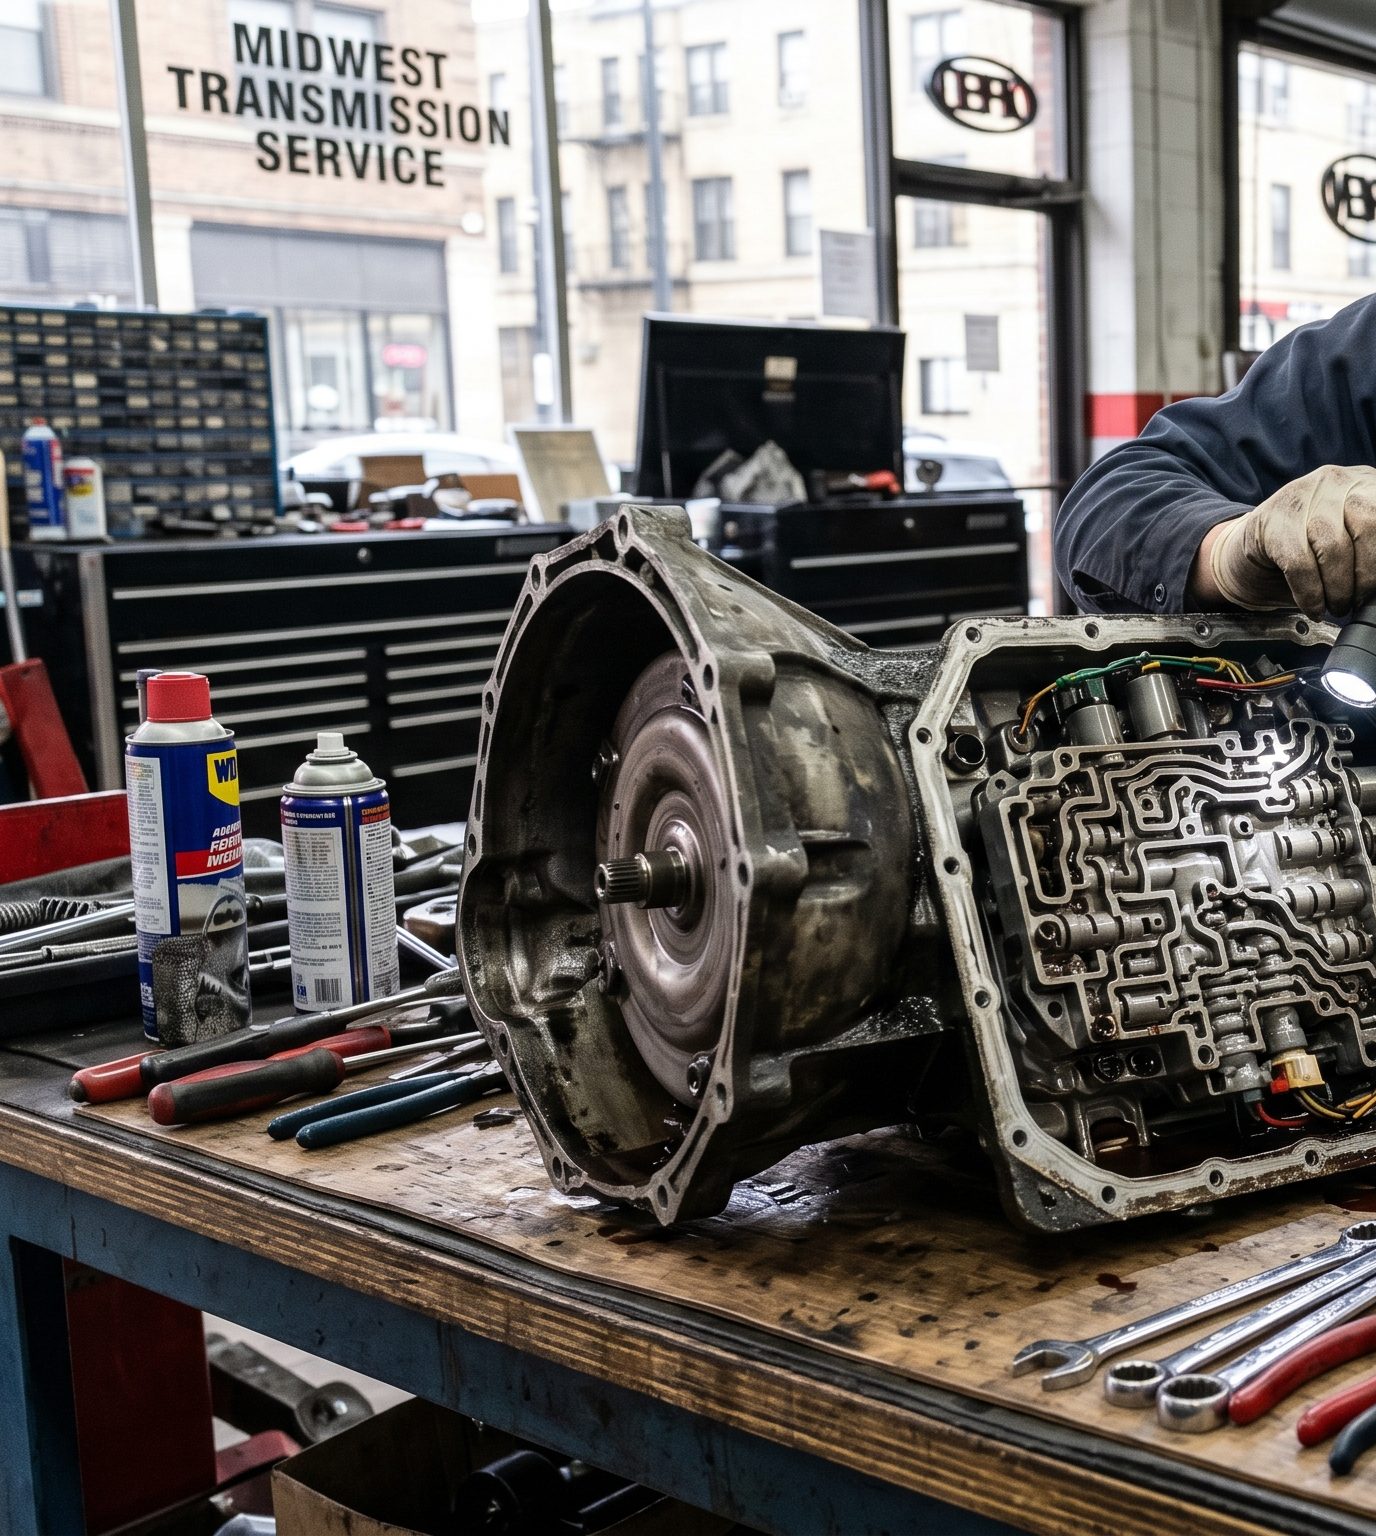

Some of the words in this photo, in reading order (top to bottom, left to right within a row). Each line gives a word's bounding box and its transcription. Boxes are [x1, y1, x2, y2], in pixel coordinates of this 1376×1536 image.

[233, 22, 448, 90] MIDWEST
[166, 65, 511, 146] TRANSMISSION
[256, 130, 445, 188] SERVICE
